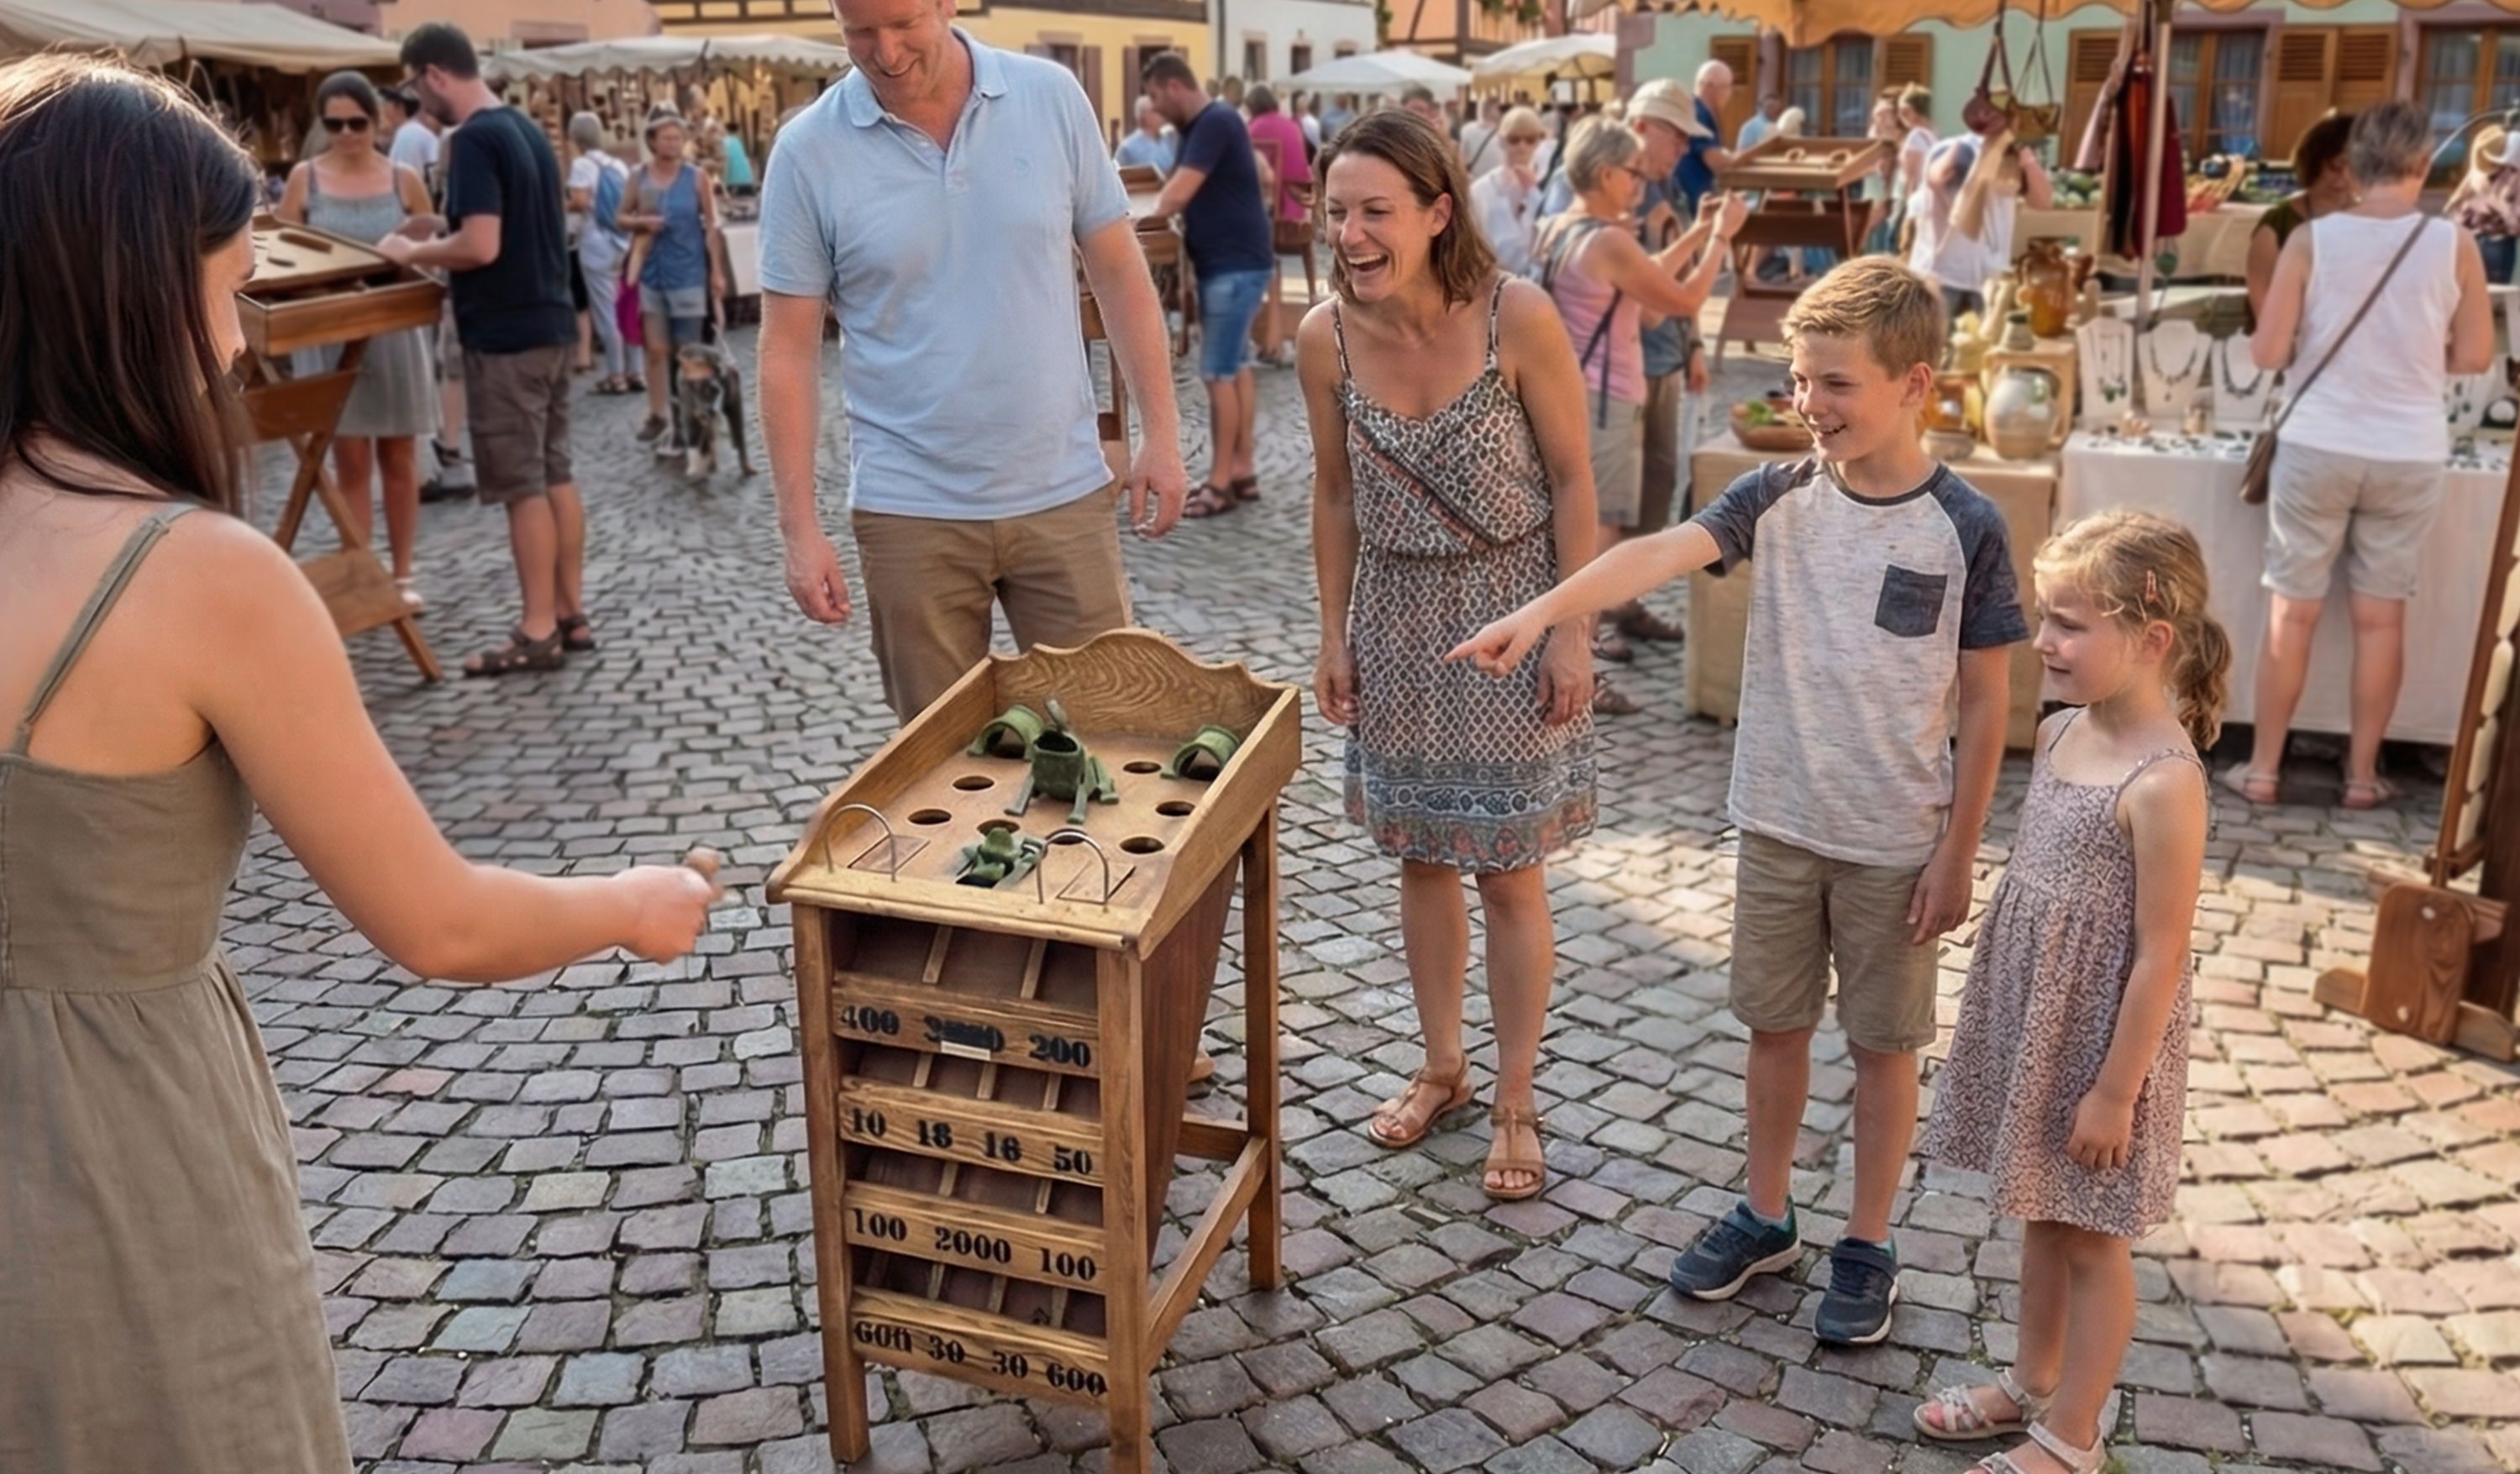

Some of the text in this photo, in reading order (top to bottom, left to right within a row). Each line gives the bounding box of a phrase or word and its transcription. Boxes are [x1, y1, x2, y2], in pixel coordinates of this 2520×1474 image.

[1027, 1033, 1091, 1067] 200
[851, 1107, 887, 1137] 10
[1053, 1145, 1093, 1174] 50
[852, 1208, 1097, 1281] 100 2000 100
[927, 1334, 967, 1364] 30
[991, 1350, 1029, 1378] 30
[1045, 1361, 1108, 1397] 600
